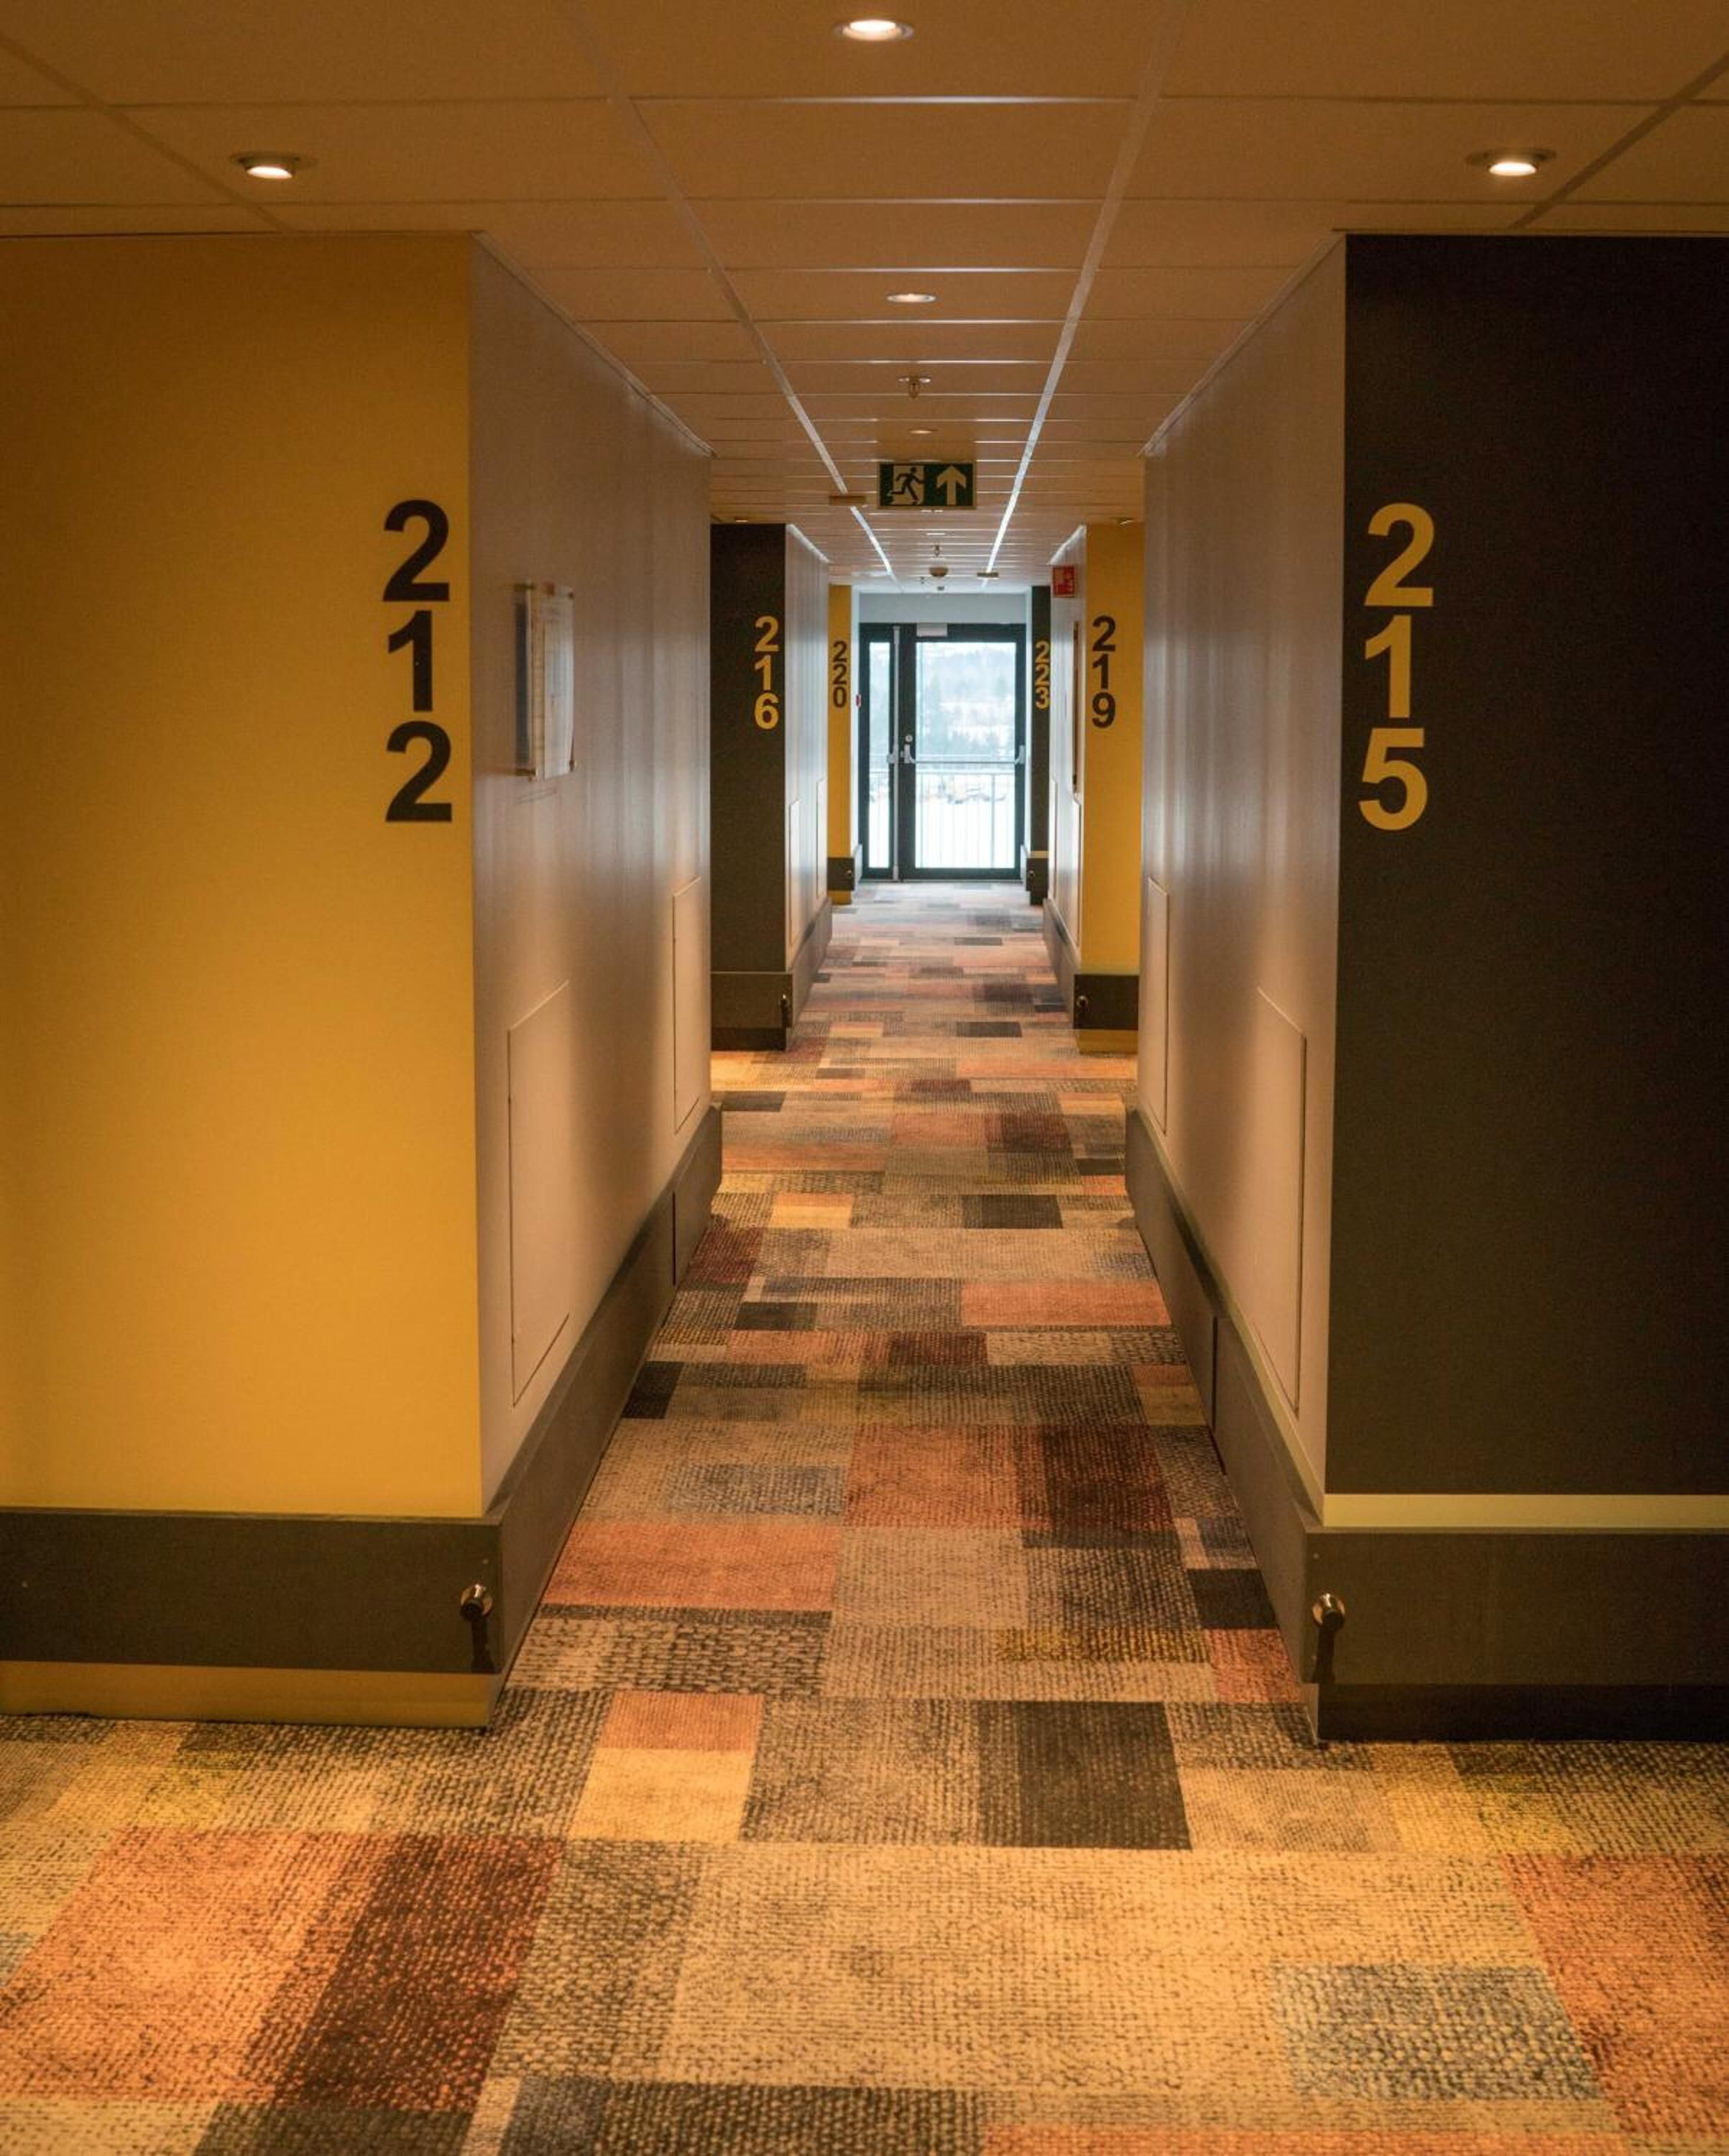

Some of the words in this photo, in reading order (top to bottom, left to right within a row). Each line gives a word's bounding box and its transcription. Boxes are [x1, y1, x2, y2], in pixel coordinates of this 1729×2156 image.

[382, 499, 452, 823] 212
[755, 615, 779, 729] 216
[833, 640, 847, 708] 220
[1035, 640, 1050, 710] 223
[1092, 615, 1116, 728] 219
[1359, 502, 1435, 831] 215
